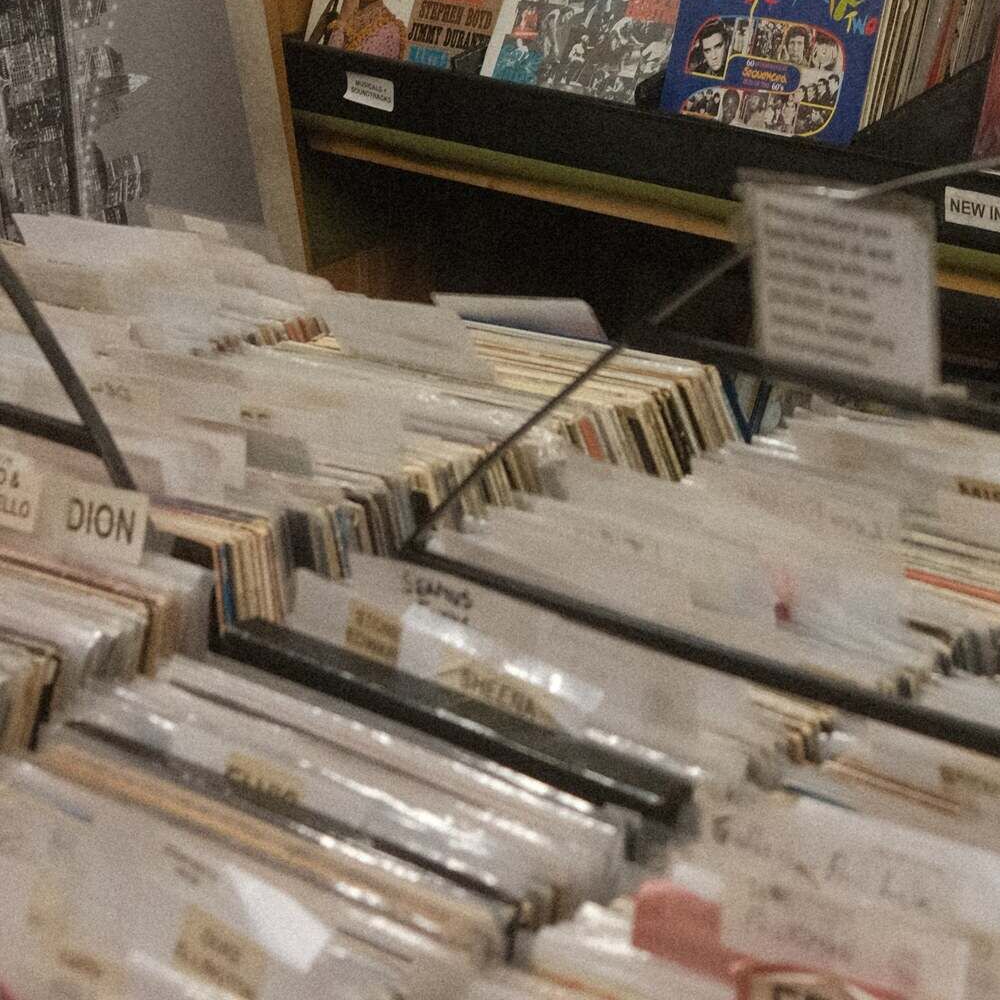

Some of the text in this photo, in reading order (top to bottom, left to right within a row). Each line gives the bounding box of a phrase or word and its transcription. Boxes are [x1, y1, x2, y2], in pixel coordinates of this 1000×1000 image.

[418, 0, 494, 31] STEPHEN BOYD
[844, 10, 878, 36] TWO
[408, 22, 443, 46] JIMMY
[949, 198, 985, 219] NEW
[66, 497, 136, 545] DION
